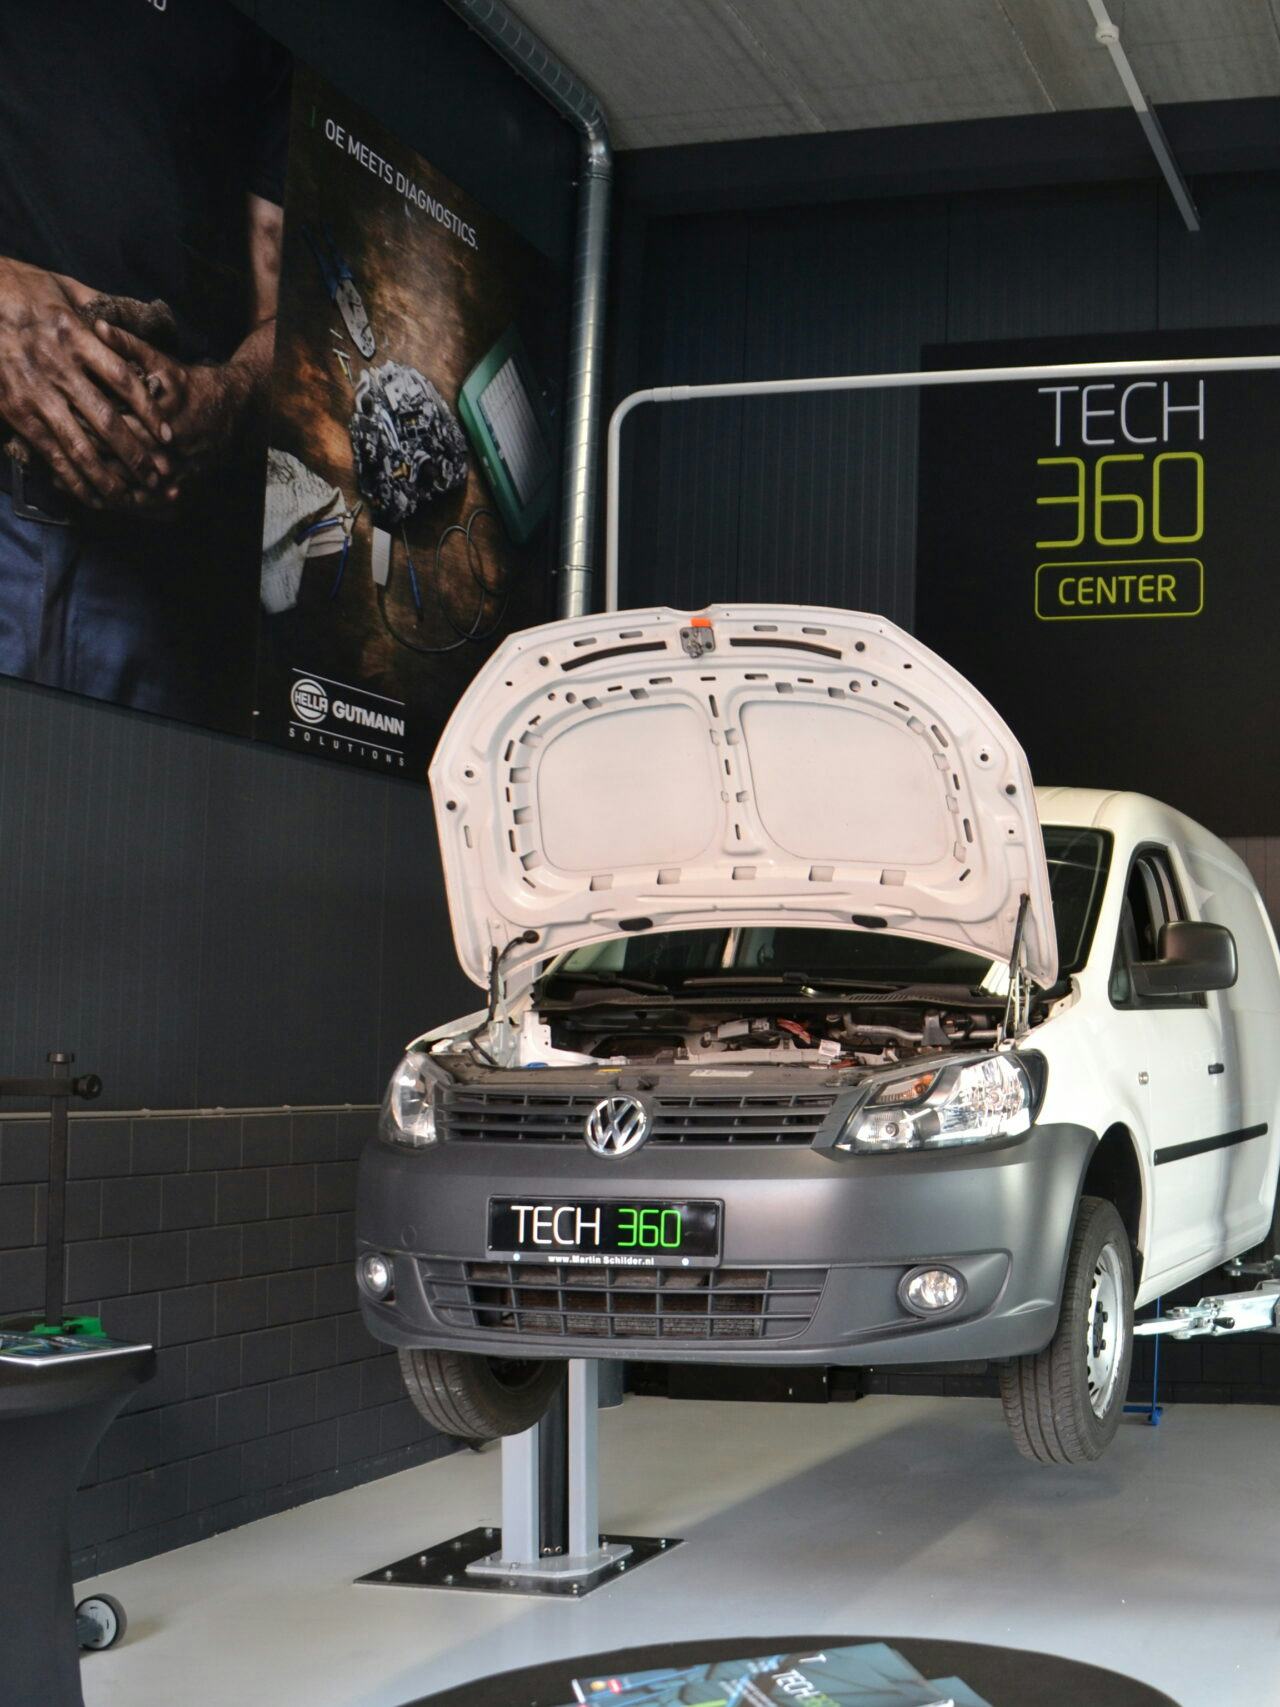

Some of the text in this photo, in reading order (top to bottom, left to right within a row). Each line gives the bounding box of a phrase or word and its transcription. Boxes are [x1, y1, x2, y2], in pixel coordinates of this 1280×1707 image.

[325, 119, 479, 250] OE MEETS DIAGNOSTICS.
[1038, 379, 1205, 447] TECH
[1036, 451, 1204, 548] 360
[1058, 574, 1177, 605] CENTER
[294, 689, 405, 736] HELLA GUTMANN
[288, 727, 405, 767] SOLUTIONS
[510, 1205, 682, 1248] TECH 360
